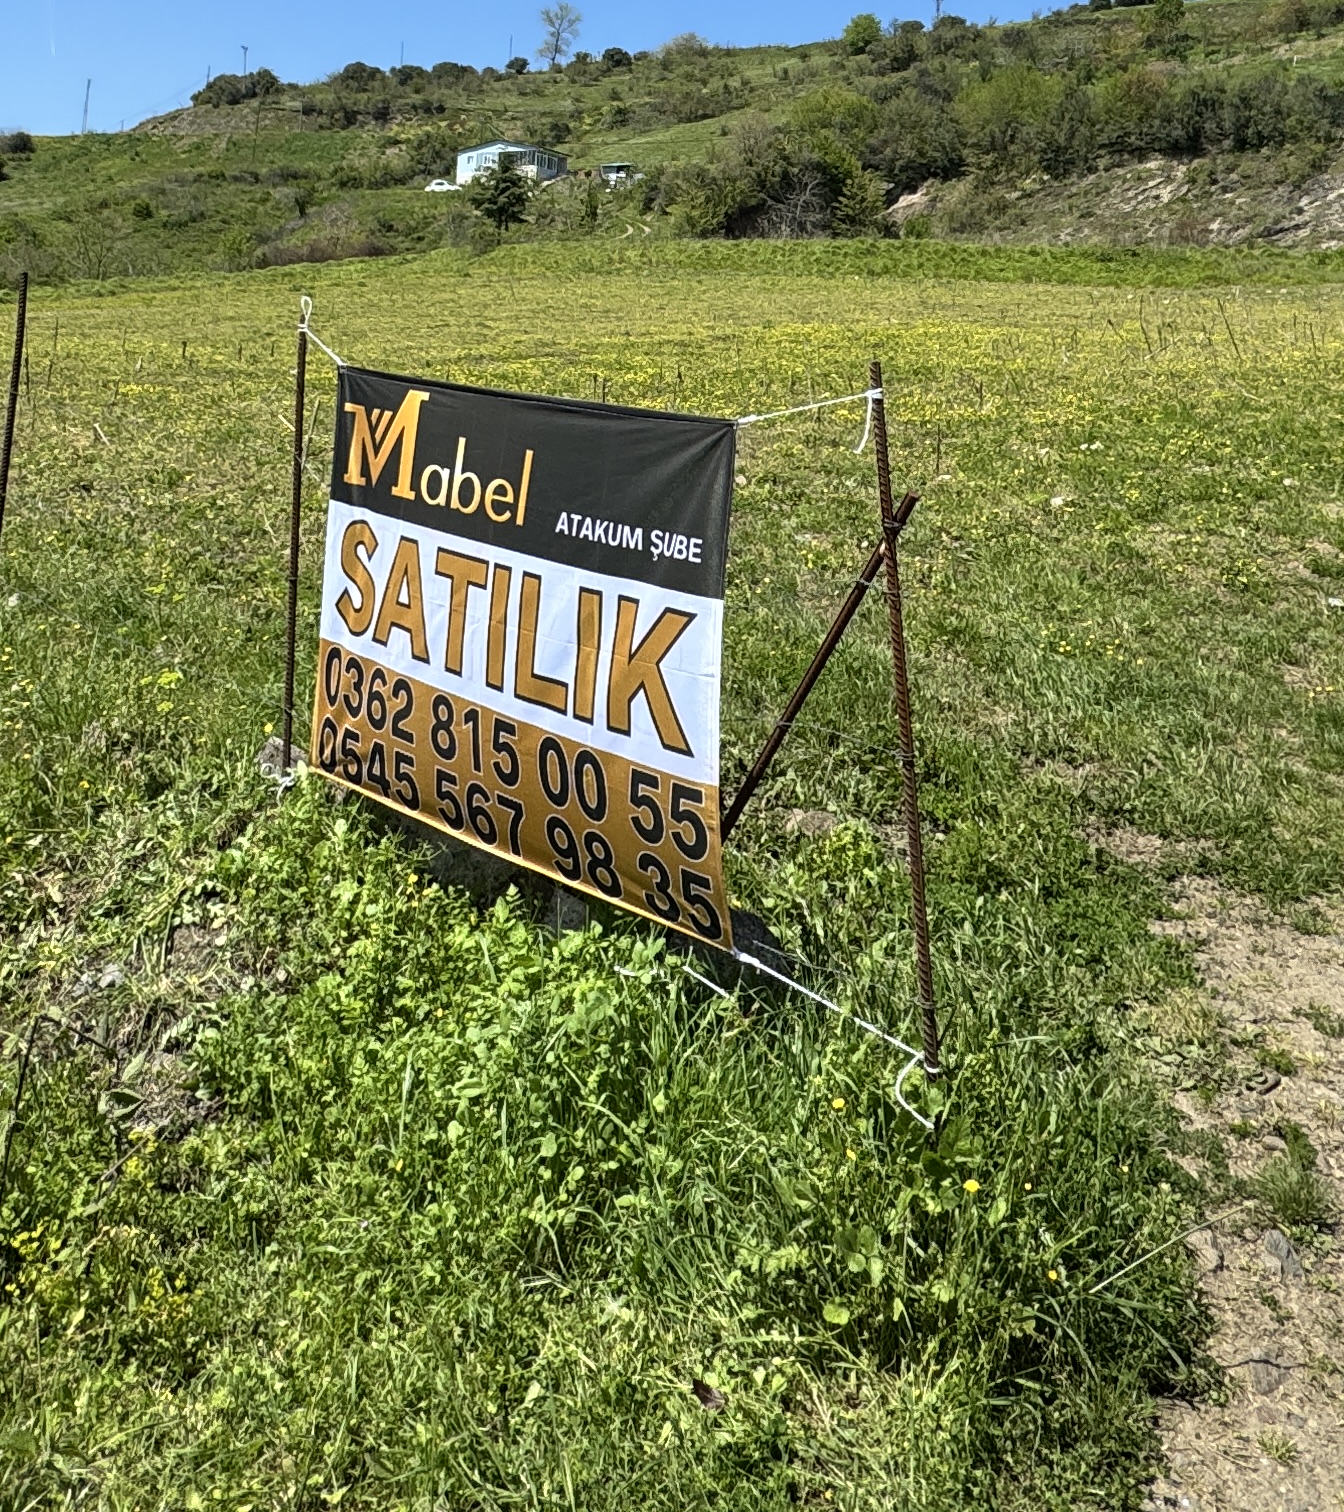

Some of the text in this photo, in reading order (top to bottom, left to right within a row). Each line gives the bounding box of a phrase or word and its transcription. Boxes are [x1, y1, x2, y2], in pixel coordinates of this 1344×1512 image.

[343, 389, 535, 527] Mabel
[555, 511, 704, 564] ATAKUM ŞUBE
[335, 519, 698, 758] SATILIK
[317, 715, 723, 941] 0545 567 98 35
[325, 645, 711, 863] 0362 815 00 55
